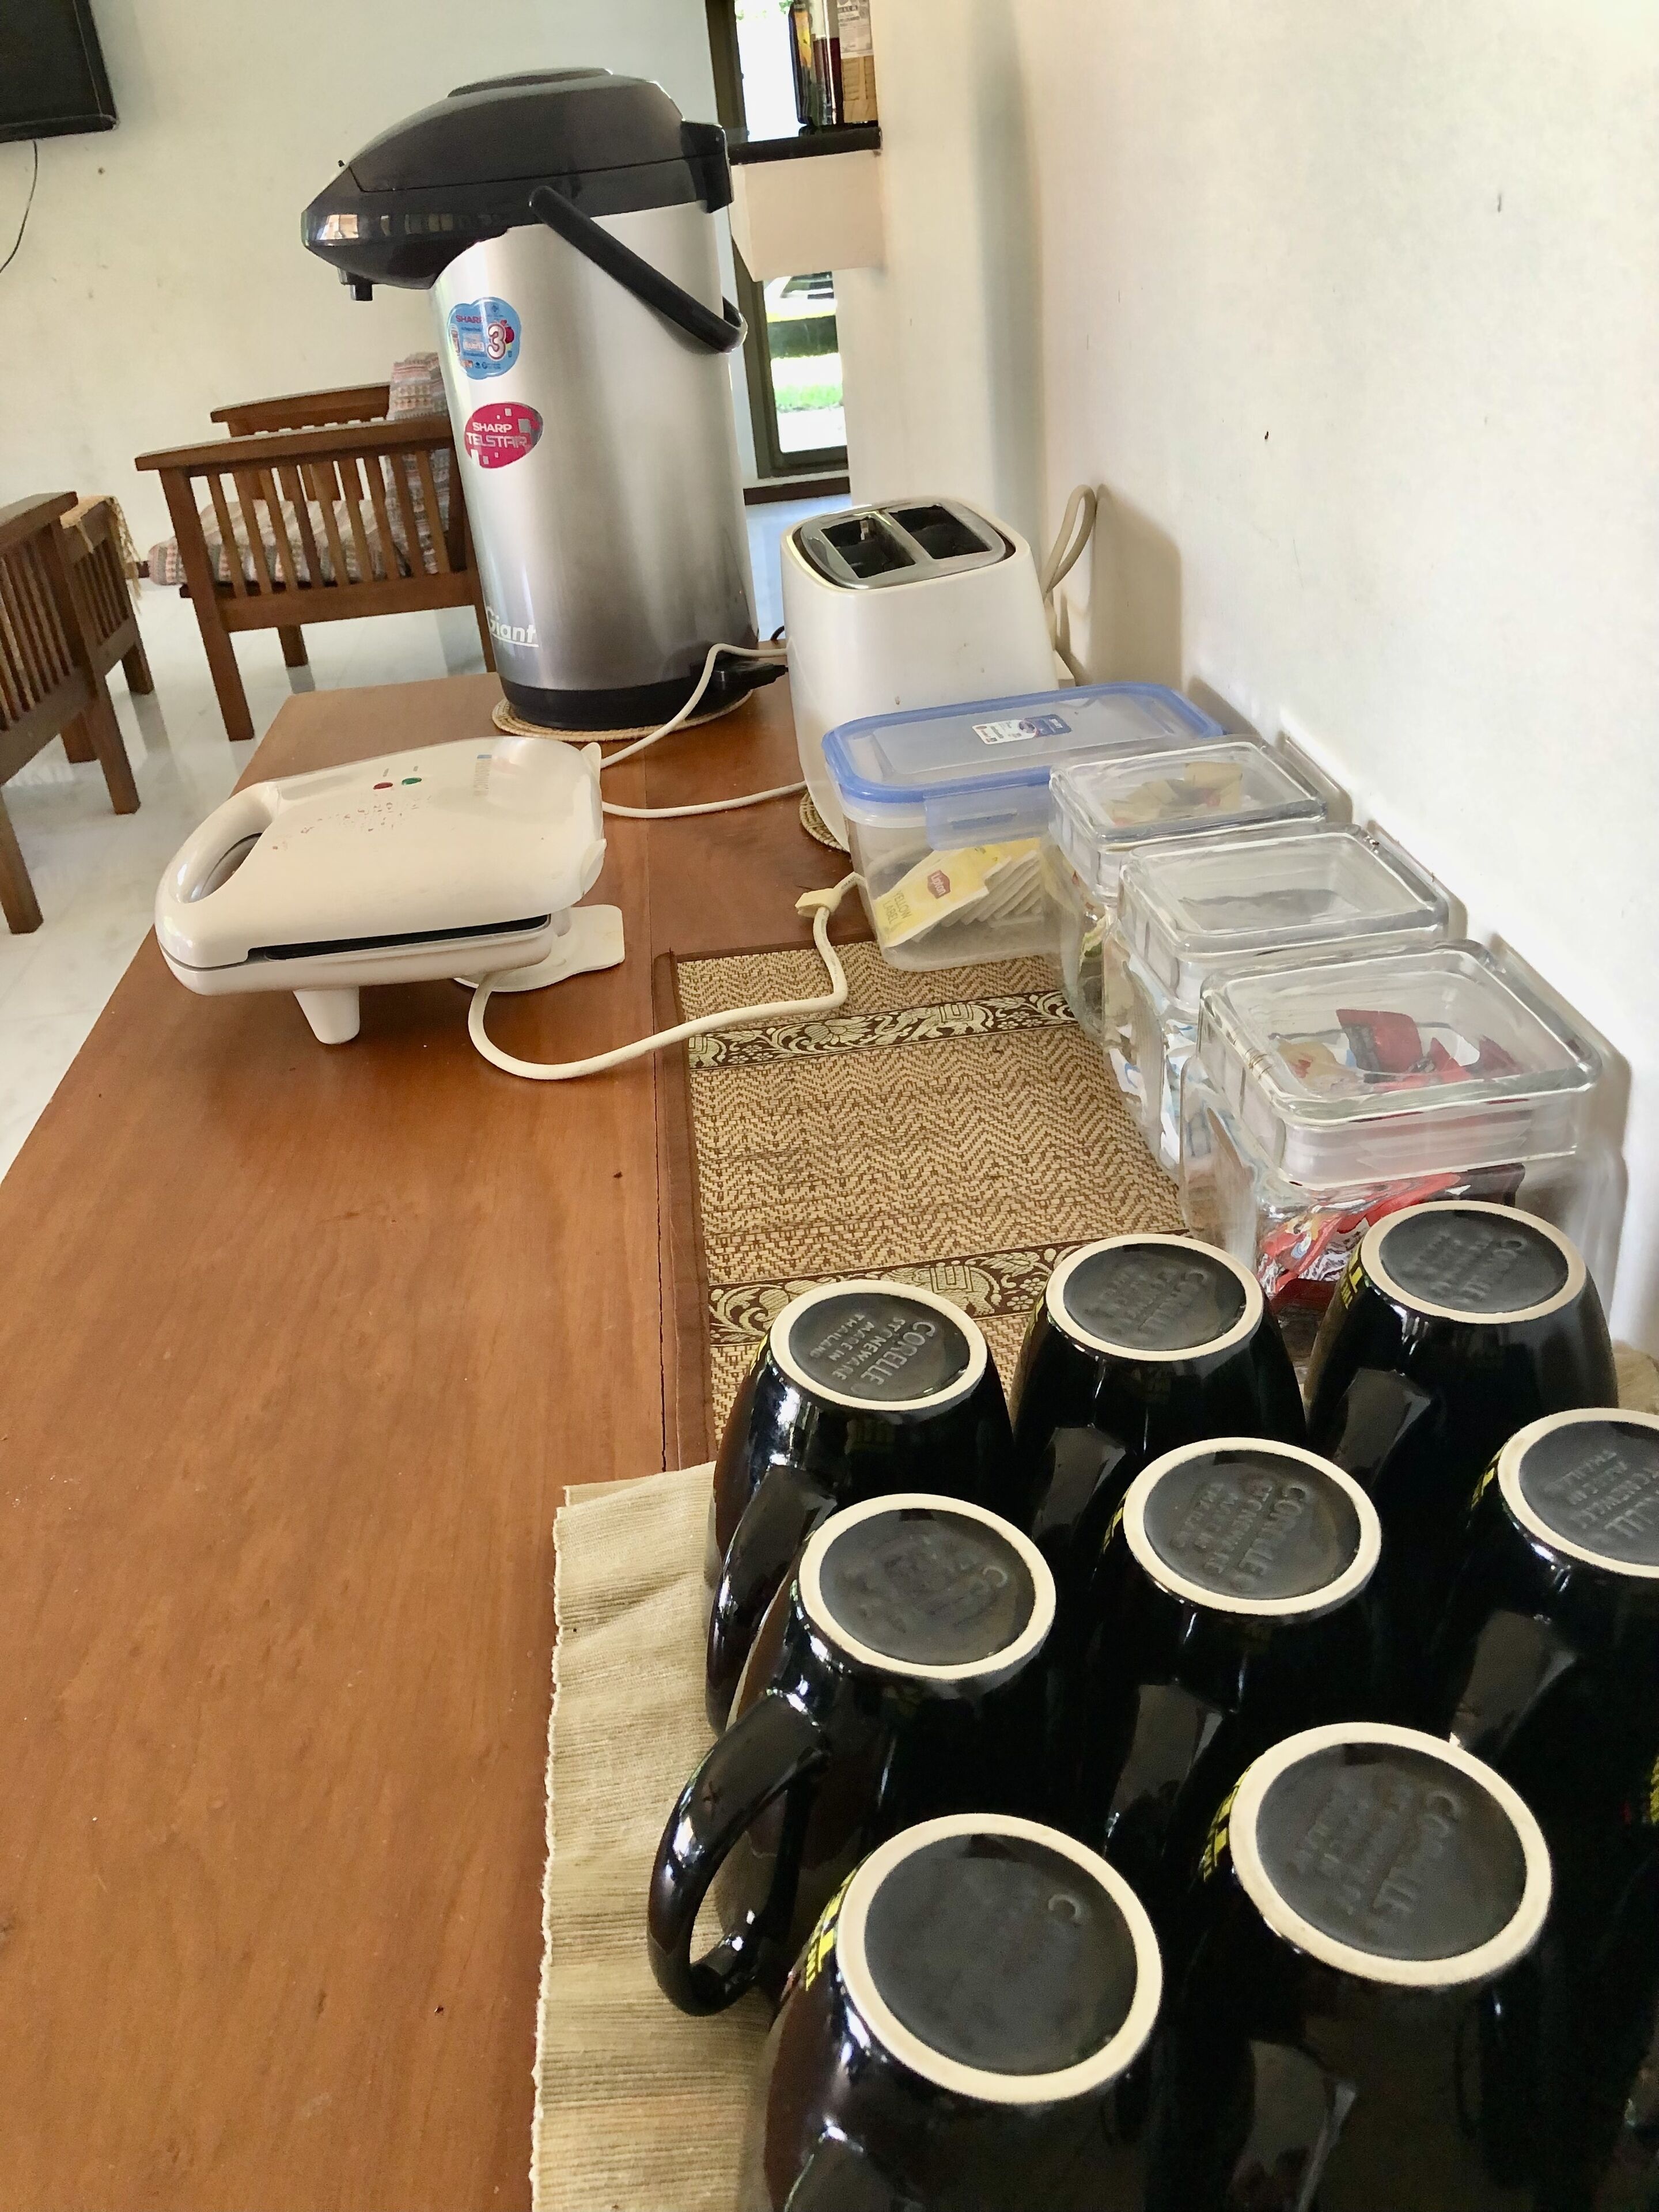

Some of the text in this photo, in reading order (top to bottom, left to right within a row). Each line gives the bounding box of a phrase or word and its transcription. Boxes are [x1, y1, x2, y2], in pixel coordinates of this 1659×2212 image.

[487, 323, 506, 361] 3
[472, 421, 512, 433] SHARP
[930, 872, 946, 896] Lipton
[883, 901, 899, 923] LABEL
[893, 891, 912, 919] YELLOW
[808, 1313, 866, 1358] THAILAND
[827, 1321, 875, 1361] MADE IN
[831, 1316, 906, 1380] STONEWARE
[859, 1321, 936, 1386] CORELLE
